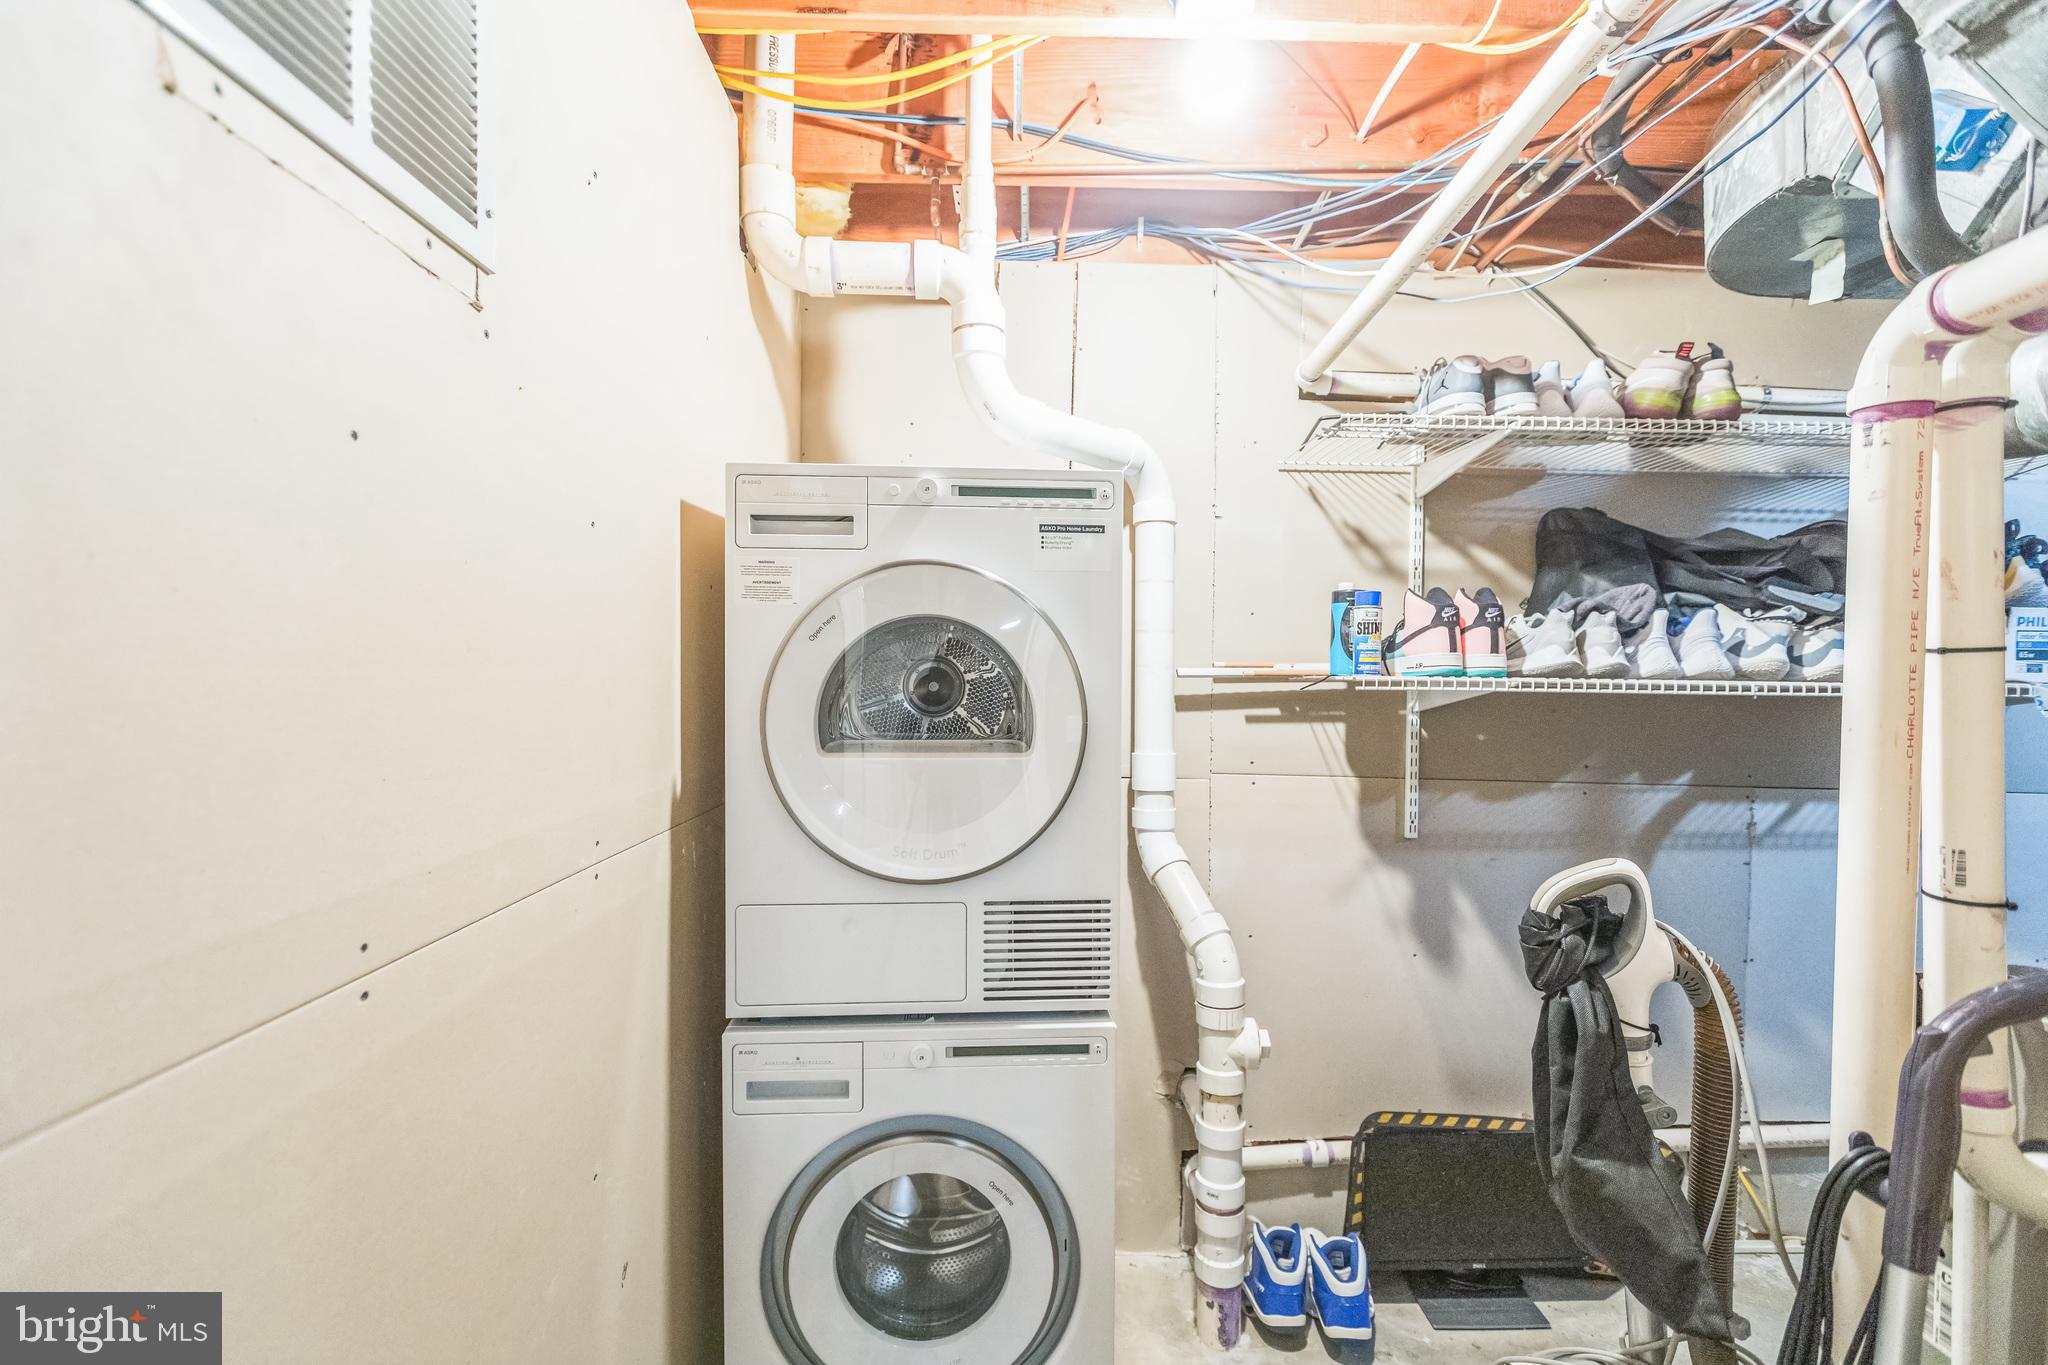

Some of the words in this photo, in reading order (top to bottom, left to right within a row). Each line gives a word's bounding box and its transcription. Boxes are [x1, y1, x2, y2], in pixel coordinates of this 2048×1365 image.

[808, 626, 824, 641] Open
[822, 615, 836, 627] here
[1909, 610, 1919, 653] PIPE
[1906, 663, 1918, 759] CHARLOTTE
[892, 846, 918, 860] Soft
[989, 1180, 1003, 1195] Open
[1002, 1193, 1014, 1206] here
